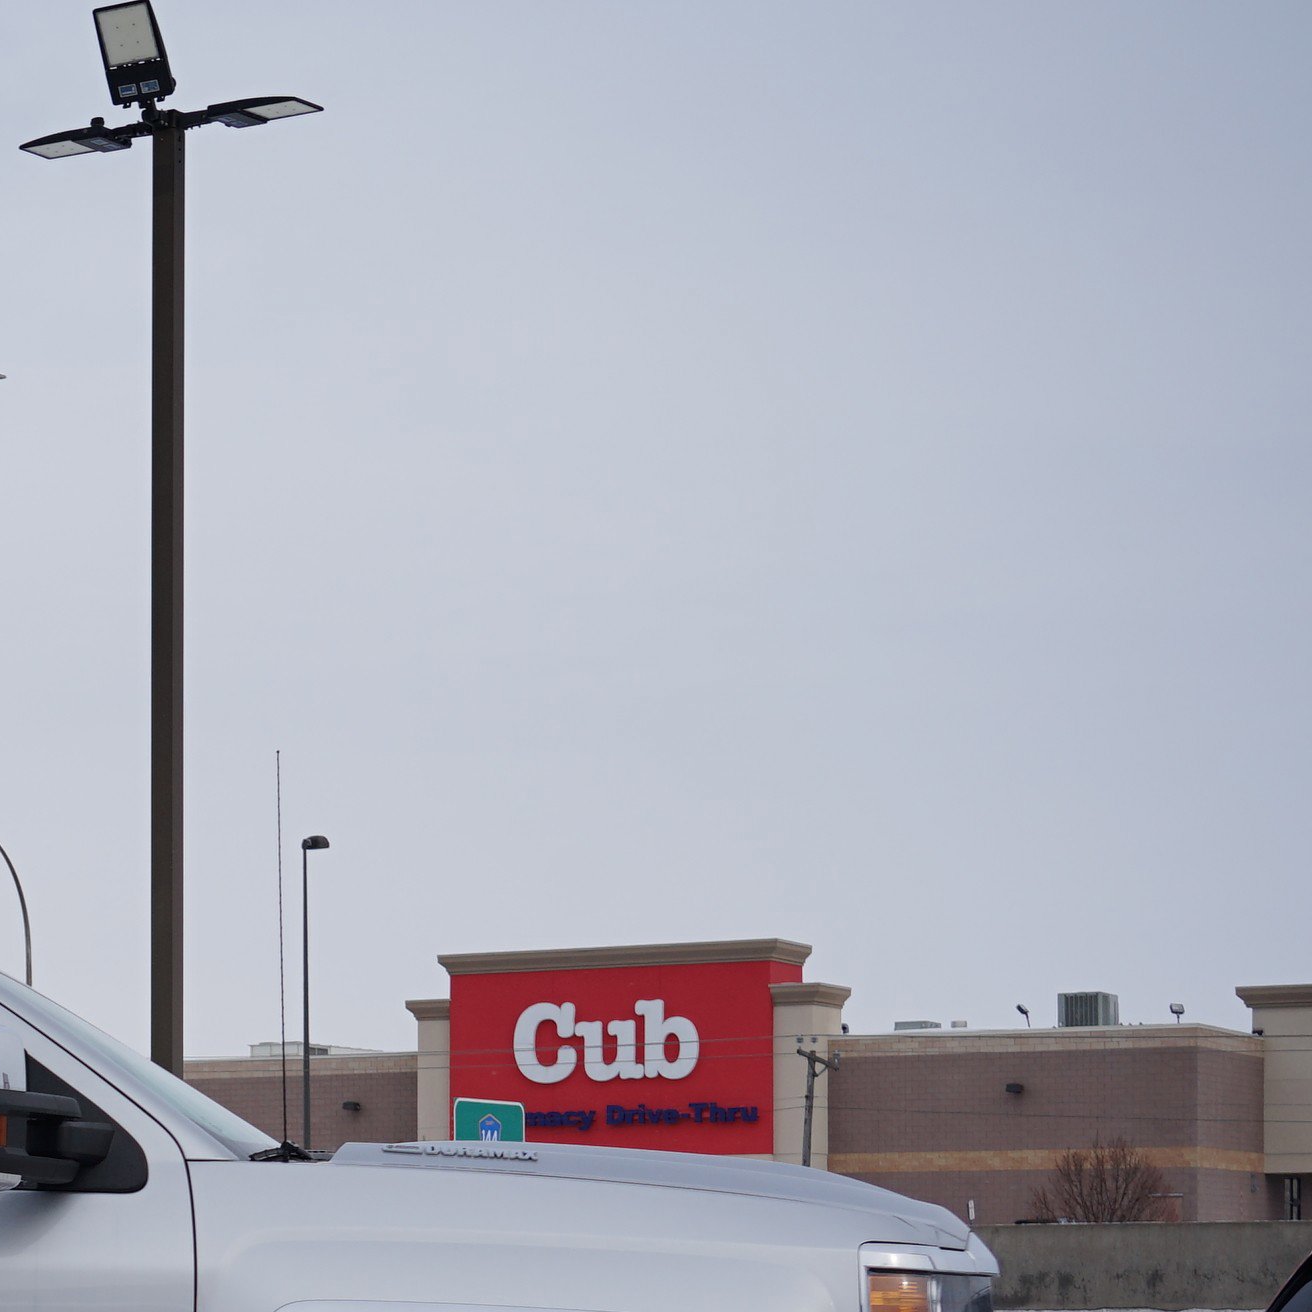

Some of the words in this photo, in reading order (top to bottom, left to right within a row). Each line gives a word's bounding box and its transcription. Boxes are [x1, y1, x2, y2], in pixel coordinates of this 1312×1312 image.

[513, 999, 699, 1084] Cub
[525, 1110, 596, 1131] macy
[606, 1103, 758, 1125] Drive-Thru
